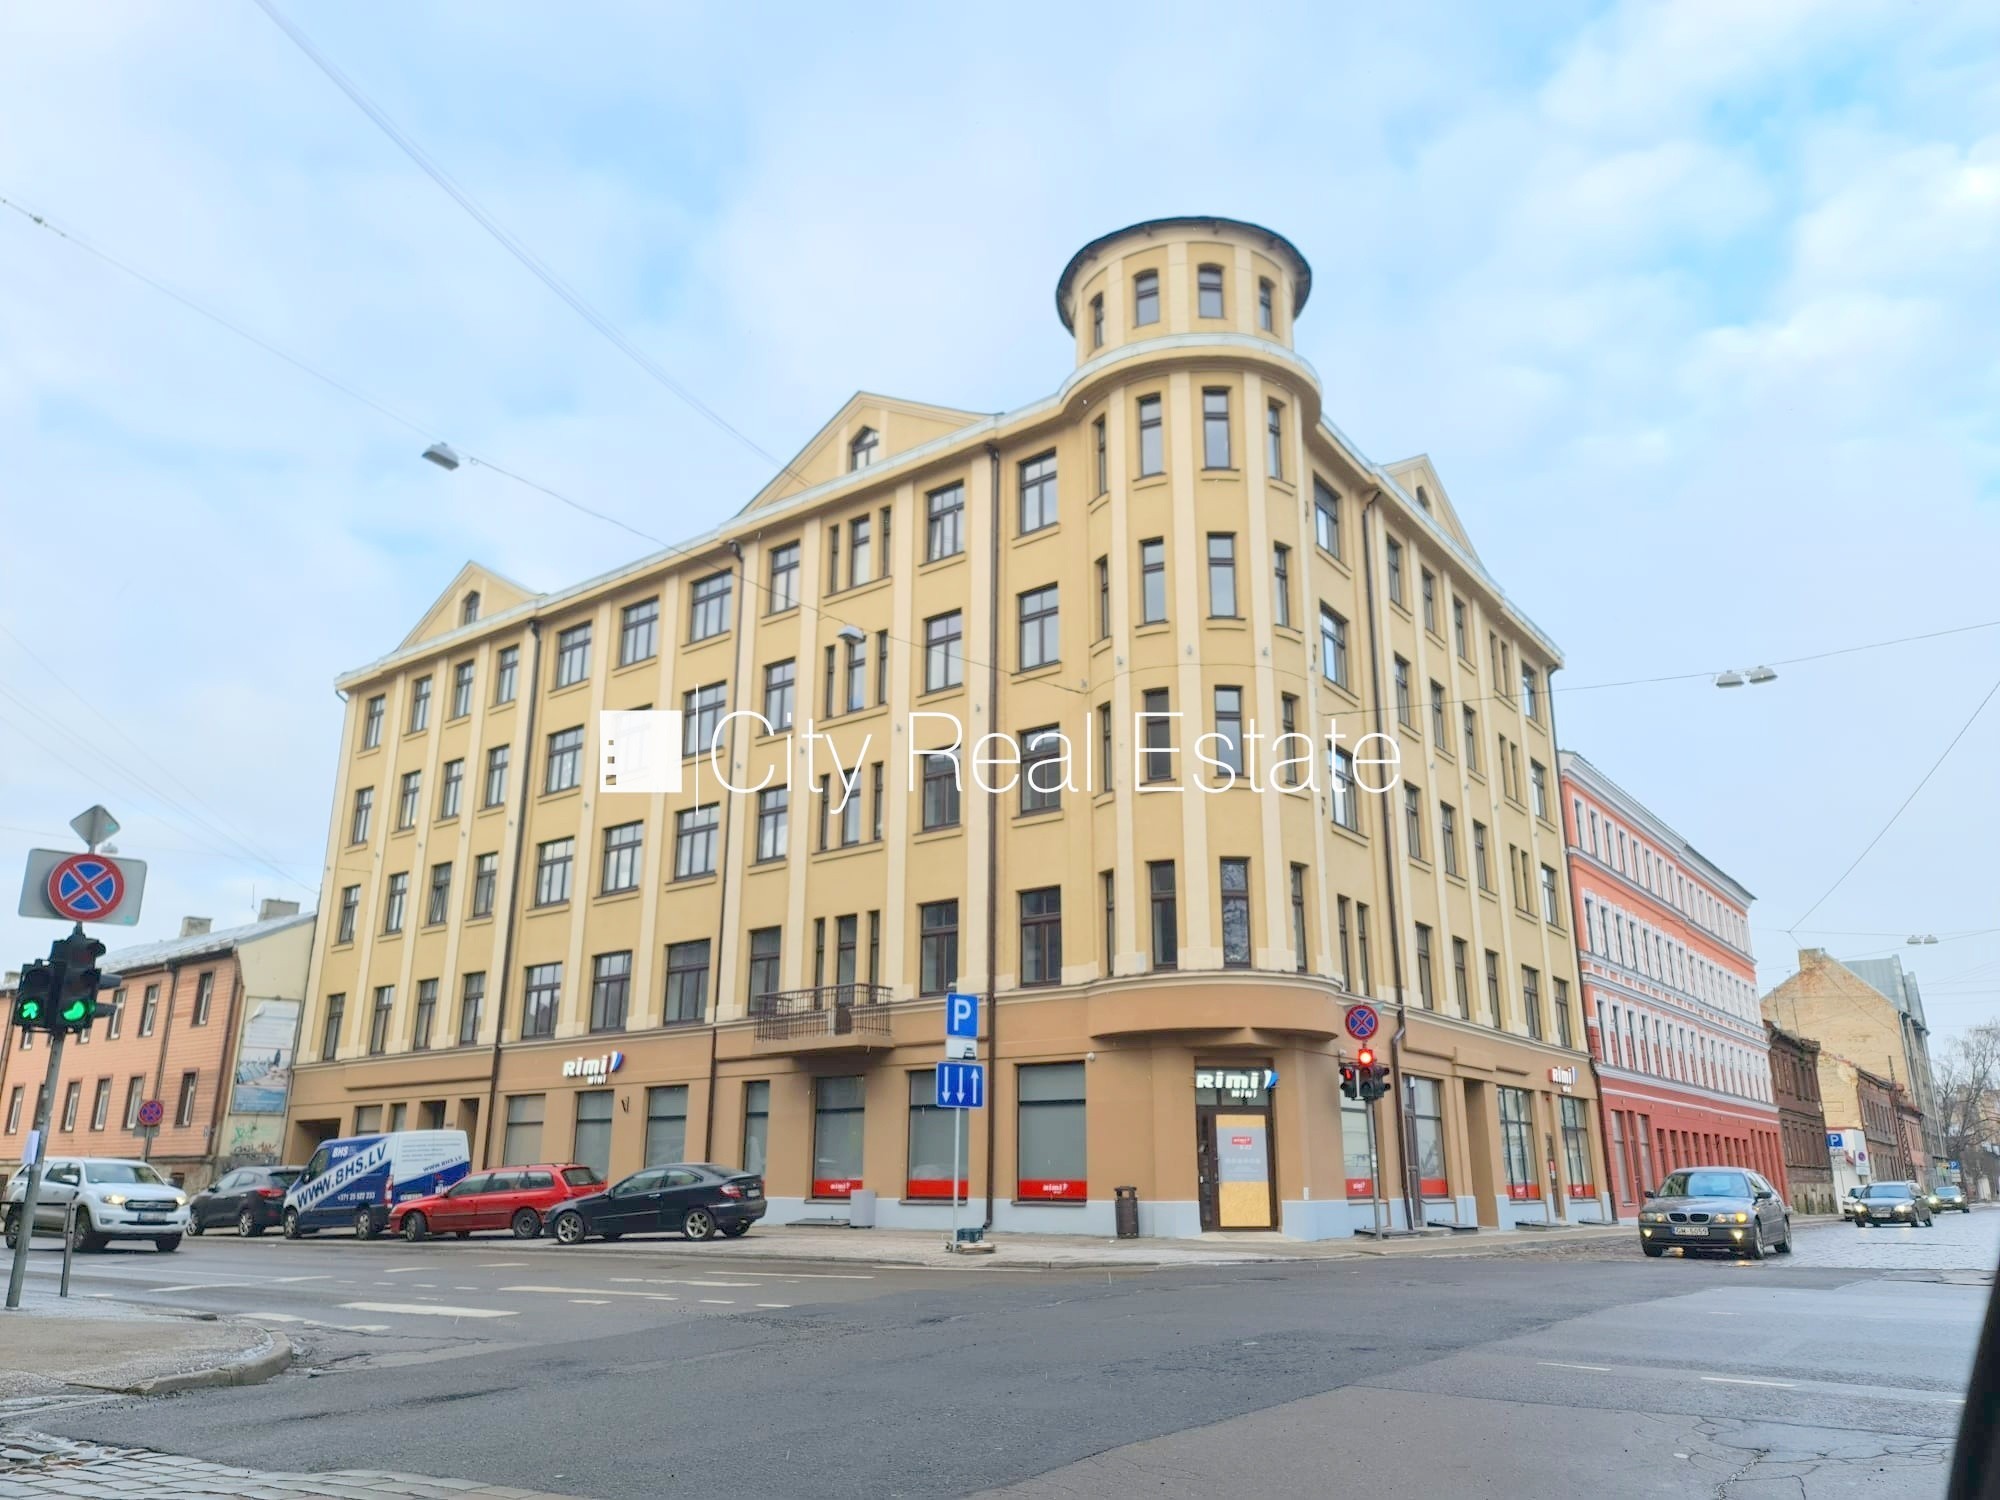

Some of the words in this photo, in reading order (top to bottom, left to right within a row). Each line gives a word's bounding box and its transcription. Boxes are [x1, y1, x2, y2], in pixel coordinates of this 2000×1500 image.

[953, 999, 971, 1031] P
[1830, 1135, 1840, 1146] P
[332, 1146, 349, 1158] BHS
[297, 1143, 387, 1208] WWW.BHS.LV
